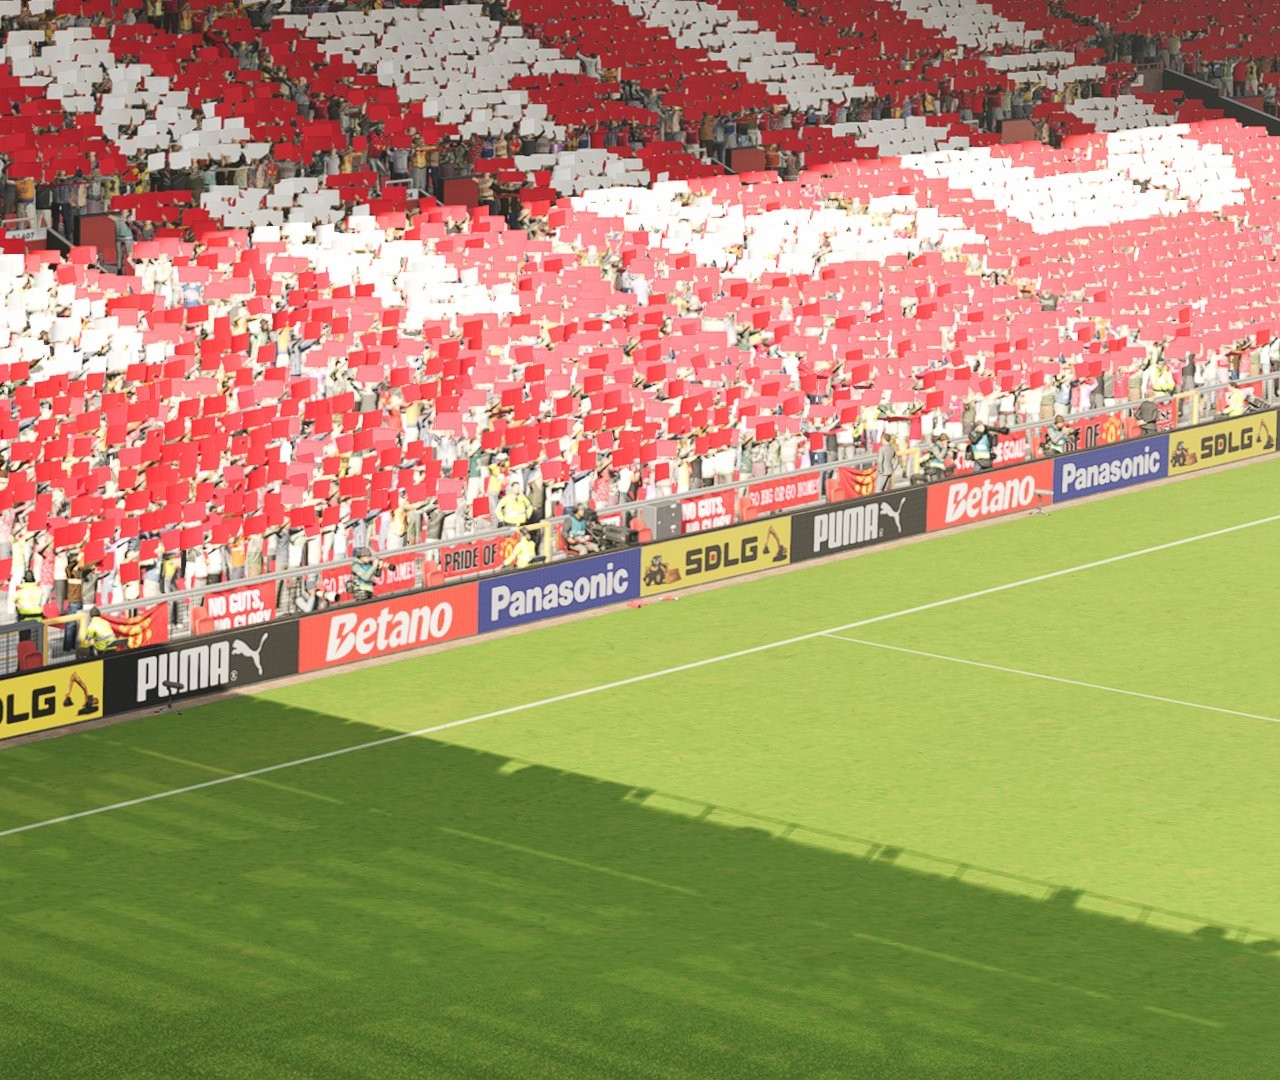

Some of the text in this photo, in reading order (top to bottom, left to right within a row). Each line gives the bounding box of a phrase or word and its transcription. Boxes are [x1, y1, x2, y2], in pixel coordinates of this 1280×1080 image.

[1200, 426, 1253, 459] SDLG
[1061, 445, 1161, 494] Panasonic
[944, 474, 1035, 523] Betano
[813, 503, 879, 552] PUMA
[444, 543, 497, 573] PRIDE OF
[685, 535, 758, 576] SDLG
[208, 589, 264, 618] NO GUTS,
[491, 562, 629, 621] Panasonic
[325, 602, 453, 663] Betano
[137, 640, 230, 702] PUMA
